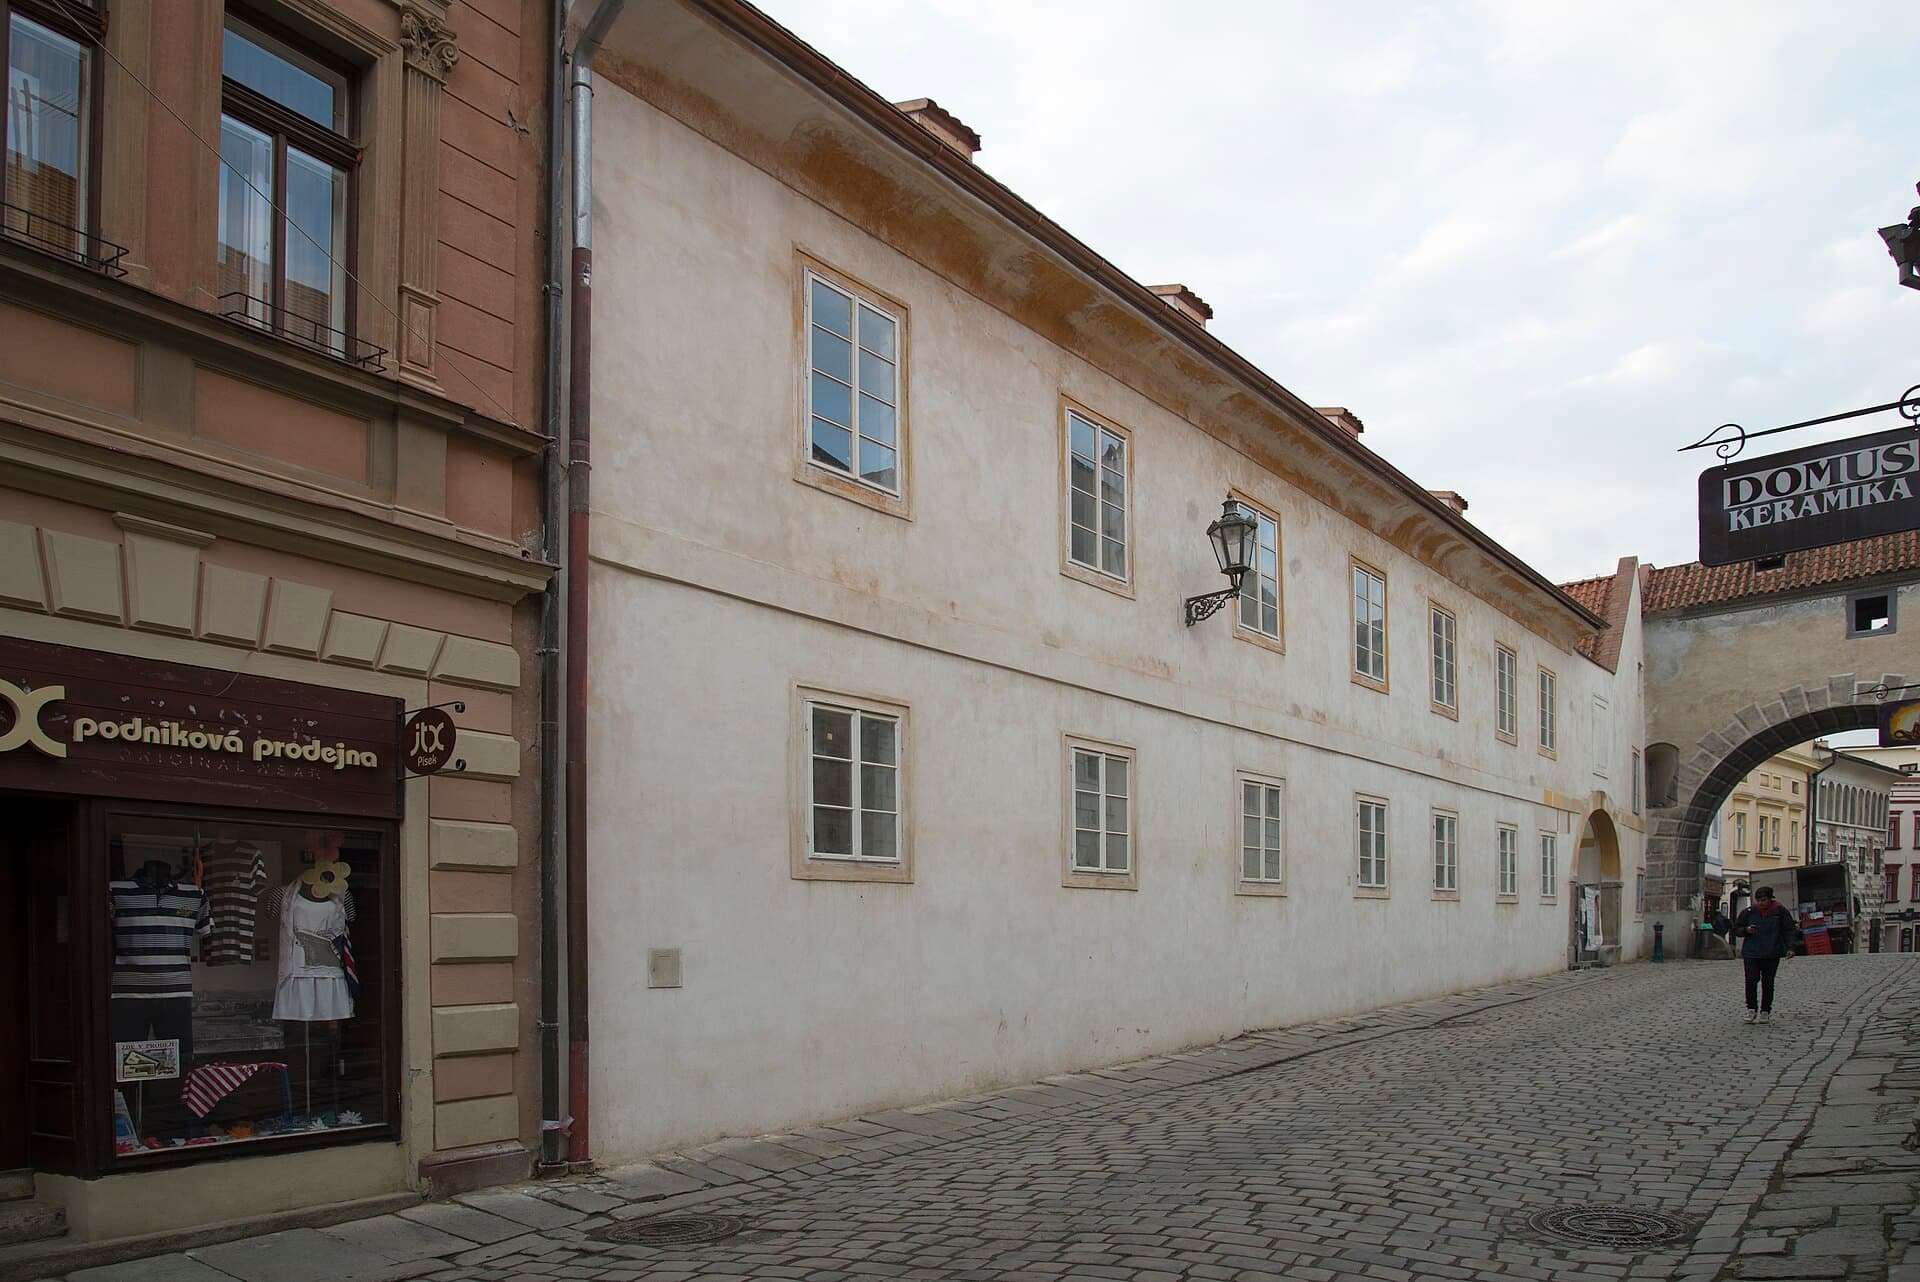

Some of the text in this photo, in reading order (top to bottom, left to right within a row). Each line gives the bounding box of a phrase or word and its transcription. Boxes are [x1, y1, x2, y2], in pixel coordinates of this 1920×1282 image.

[1727, 442, 1915, 507] DOMUS
[1728, 476, 1914, 533] KERAMIKA
[73, 716, 378, 770] podniková prodejna
